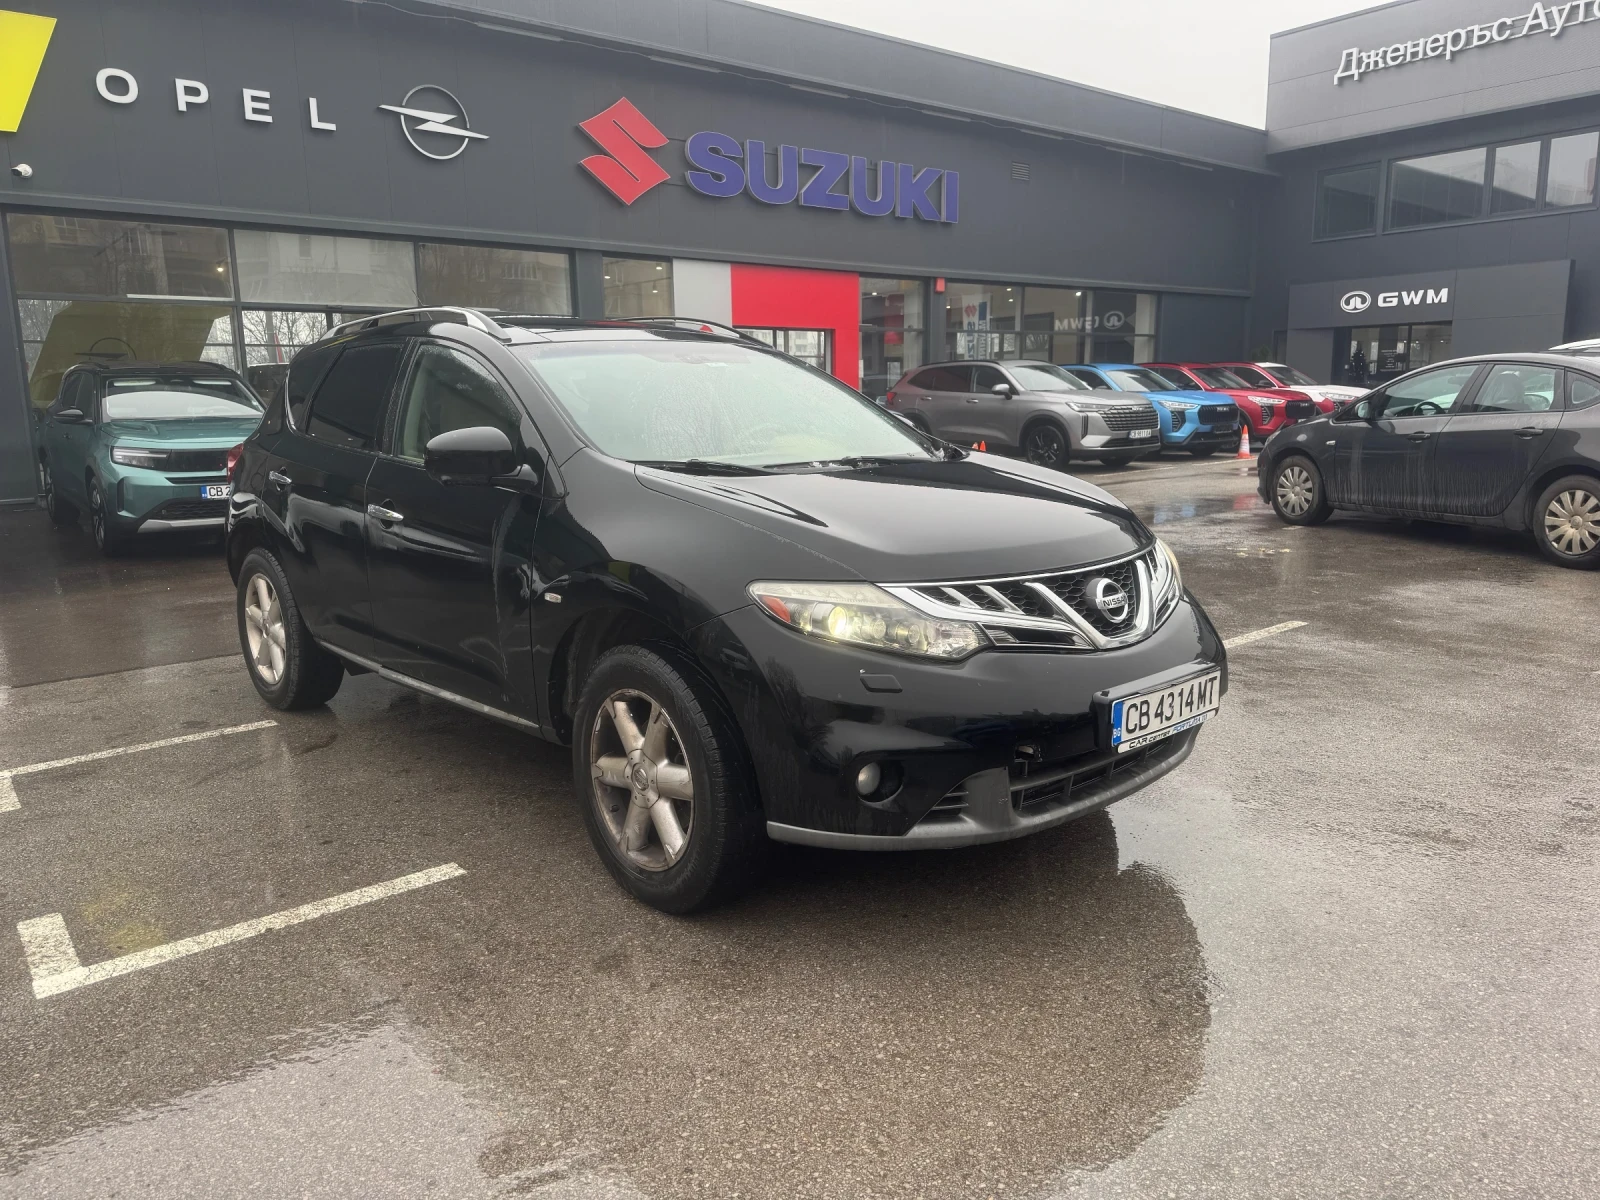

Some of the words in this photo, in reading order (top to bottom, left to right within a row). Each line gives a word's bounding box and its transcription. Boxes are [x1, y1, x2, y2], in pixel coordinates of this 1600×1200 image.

[1333, 17, 1514, 85] Дженеръс
[95, 67, 337, 132] OPEL
[685, 130, 960, 224] SUZUKI
[1377, 287, 1449, 308] GWM
[209, 486, 224, 497] CB
[1125, 699, 1151, 734] CB
[1154, 683, 1194, 724] 4314
[1196, 675, 1218, 711] MT
[1128, 737, 1148, 749] CAR
